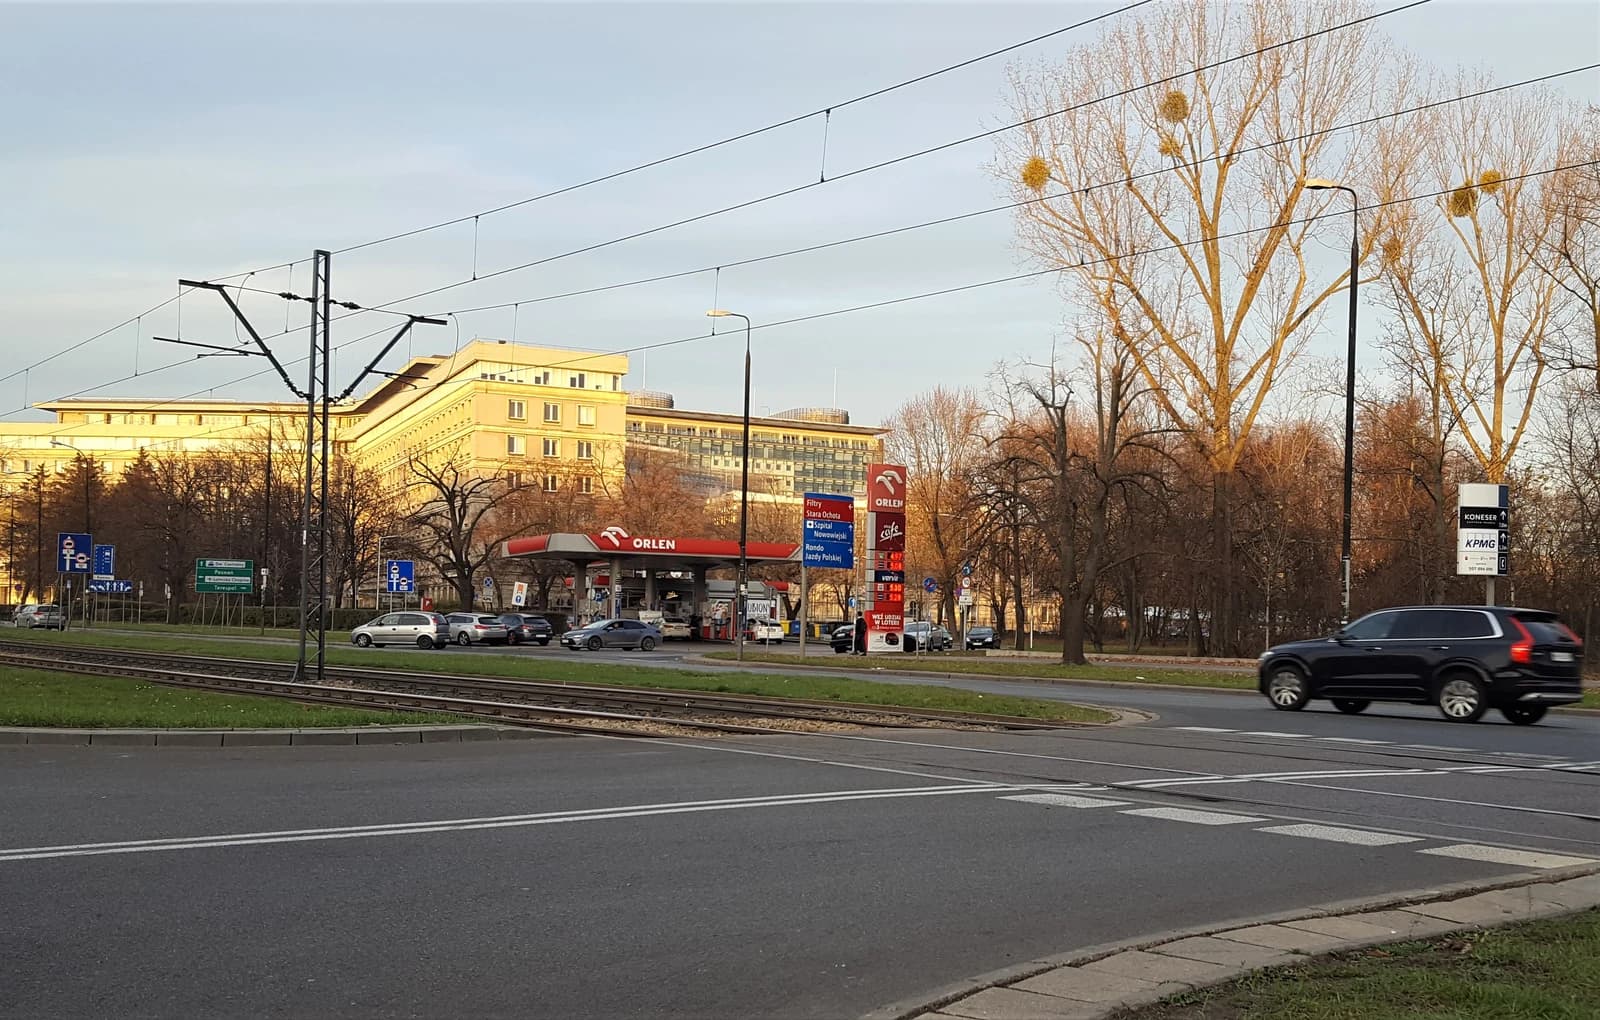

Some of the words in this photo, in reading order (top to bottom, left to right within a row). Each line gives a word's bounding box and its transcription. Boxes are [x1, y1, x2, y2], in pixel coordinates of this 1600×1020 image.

[806, 499, 822, 508] Filtry
[875, 498, 903, 508] ORLEN
[806, 510, 821, 518] Stara
[822, 511, 841, 519] Ochota
[1464, 513, 1498, 521] KONESER
[814, 522, 833, 530] Szpital
[814, 530, 847, 540] Nowowiejski
[632, 538, 676, 549] ORLEN
[805, 543, 824, 552] Rondo
[1465, 539, 1496, 549] KPMG
[805, 553, 822, 562] Jazdy
[822, 553, 842, 563] Polskiej
